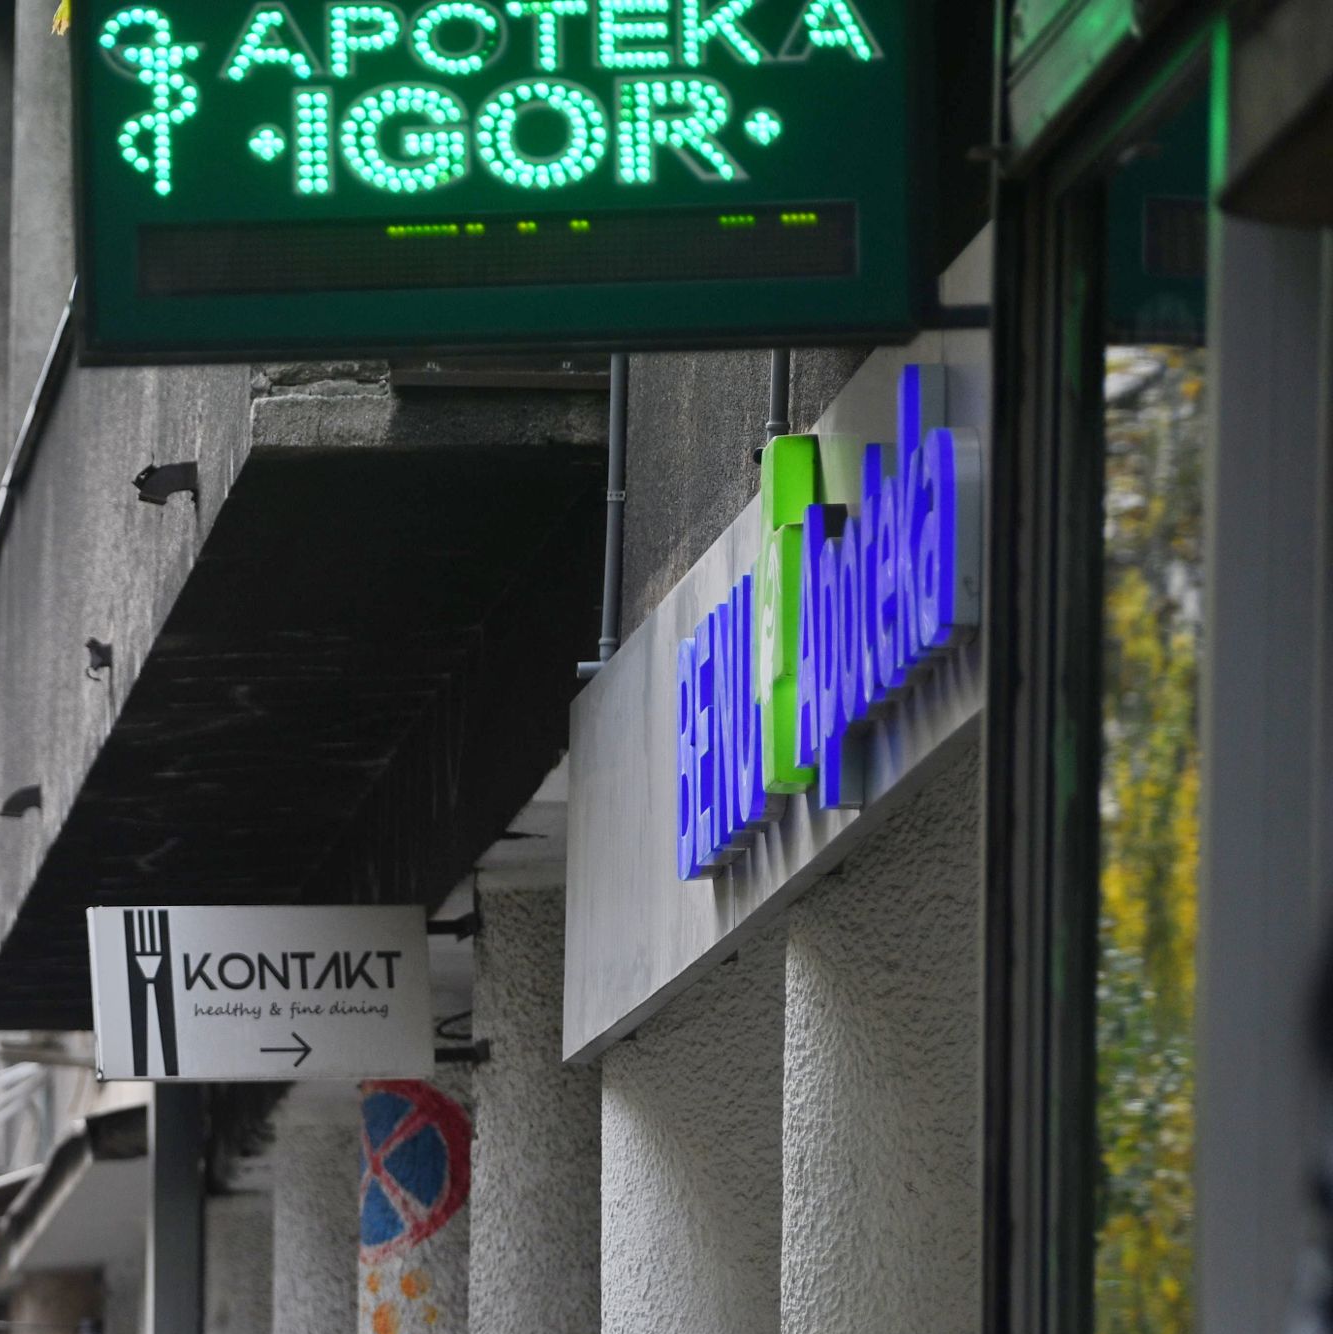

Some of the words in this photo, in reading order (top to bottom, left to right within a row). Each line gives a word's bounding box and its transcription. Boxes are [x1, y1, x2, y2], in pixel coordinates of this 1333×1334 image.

[217, 0, 885, 78] APOTEKA
[795, 364, 955, 810] Apoteka
[677, 574, 763, 881] BENU
[183, 949, 402, 991] KONTAKT
[194, 1002, 262, 1019] healthy
[269, 1003, 282, 1016] &
[289, 1001, 325, 1019] fine
[329, 1001, 389, 1018] dining
